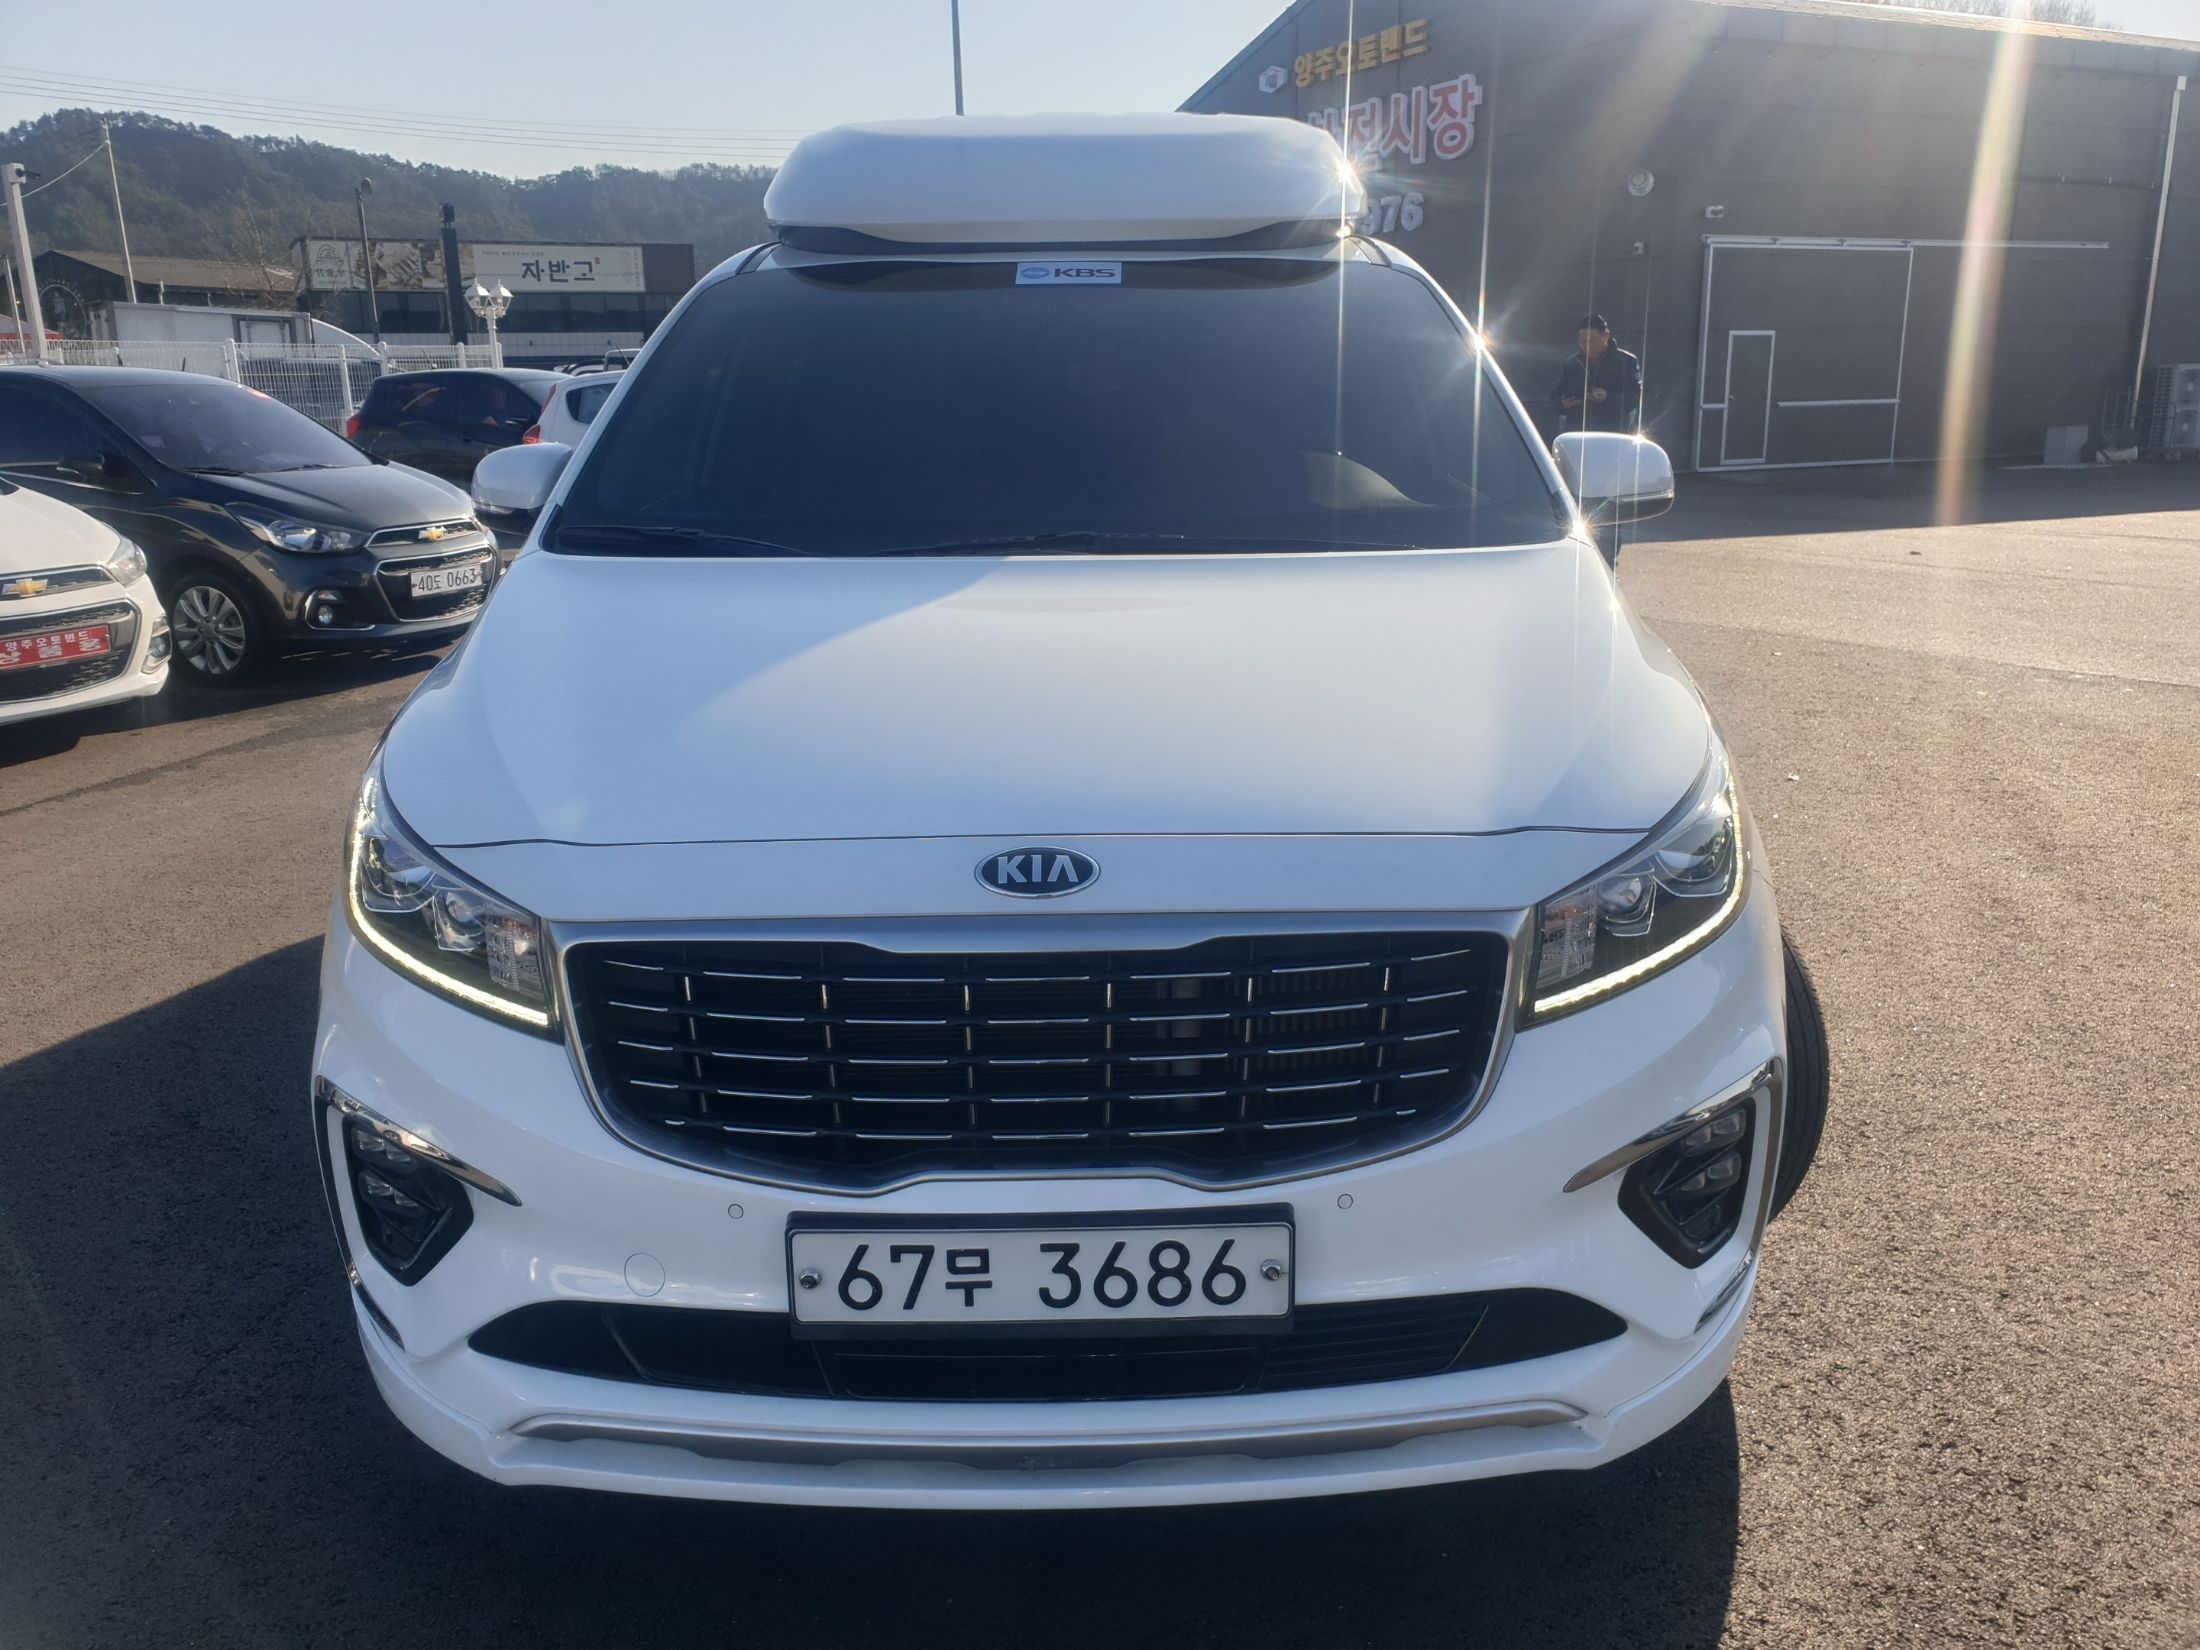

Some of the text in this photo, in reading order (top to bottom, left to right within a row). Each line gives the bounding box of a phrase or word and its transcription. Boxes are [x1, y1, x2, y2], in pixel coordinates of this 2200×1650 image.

[1294, 18, 1430, 88] 양주오토랜드
[521, 259, 595, 282] 자반고
[1054, 268, 1116, 278] KBS
[446, 568, 477, 588] 0663
[997, 854, 1079, 884] KIA
[837, 1238, 1247, 1311] 67무 3686
